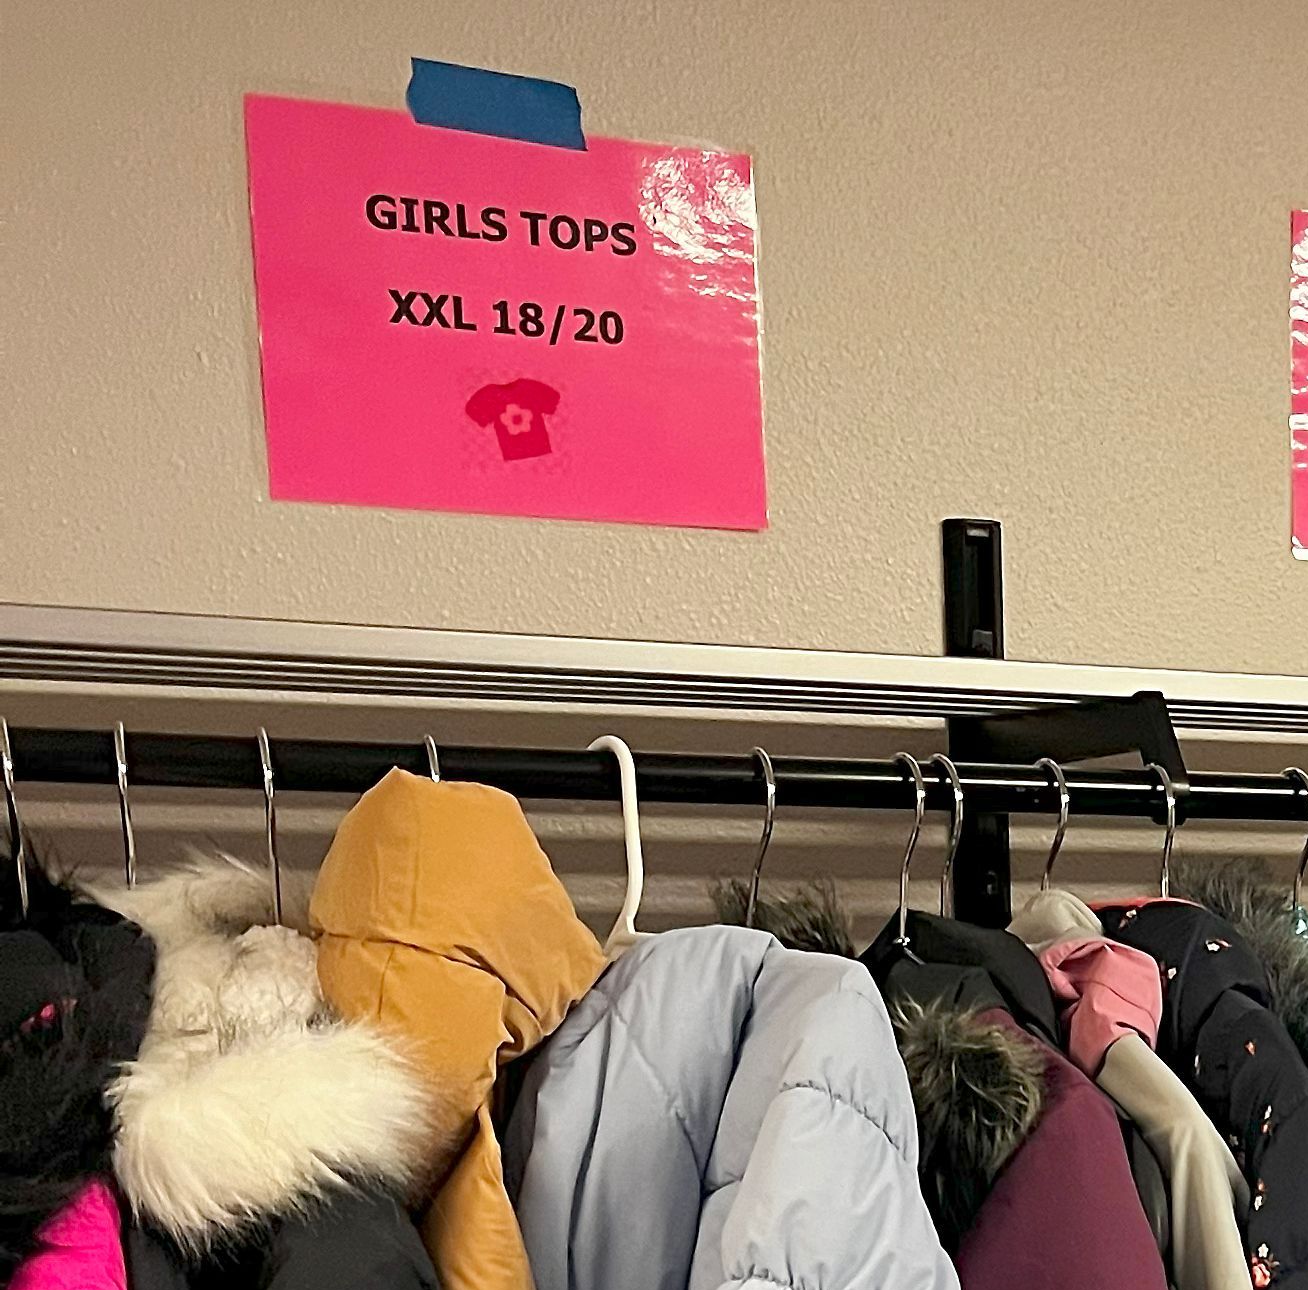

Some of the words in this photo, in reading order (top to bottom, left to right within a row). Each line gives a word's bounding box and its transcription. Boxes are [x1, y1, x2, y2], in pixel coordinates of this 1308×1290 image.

[365, 194, 508, 242] GIRLS
[519, 211, 637, 256] TOPS
[388, 289, 477, 331] XXL
[492, 300, 624, 346] 18/20
